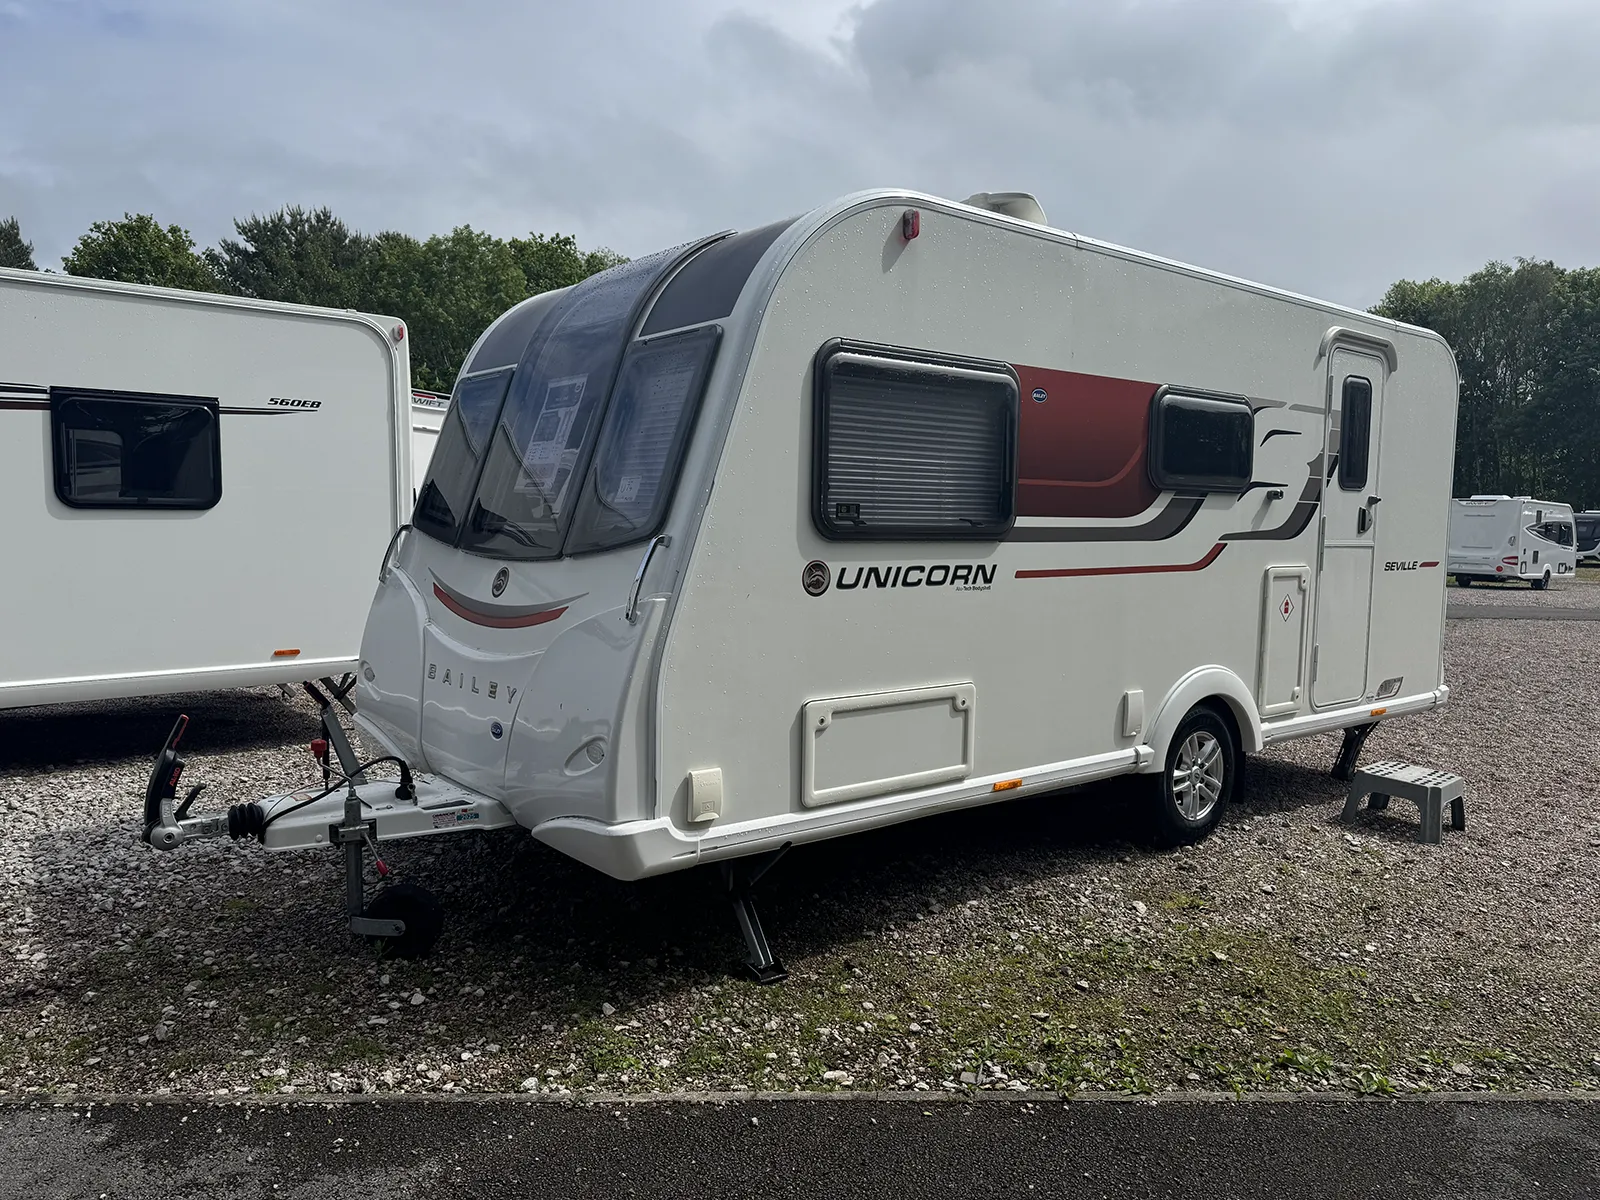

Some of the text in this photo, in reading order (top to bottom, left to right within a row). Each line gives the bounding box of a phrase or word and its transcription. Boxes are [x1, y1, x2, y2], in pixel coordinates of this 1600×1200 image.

[267, 397, 322, 408] 560EB
[412, 396, 444, 407] WIFT
[1384, 560, 1418, 571] SEVILLE
[835, 563, 998, 590] UNICORN
[427, 663, 518, 704] BAILEY
